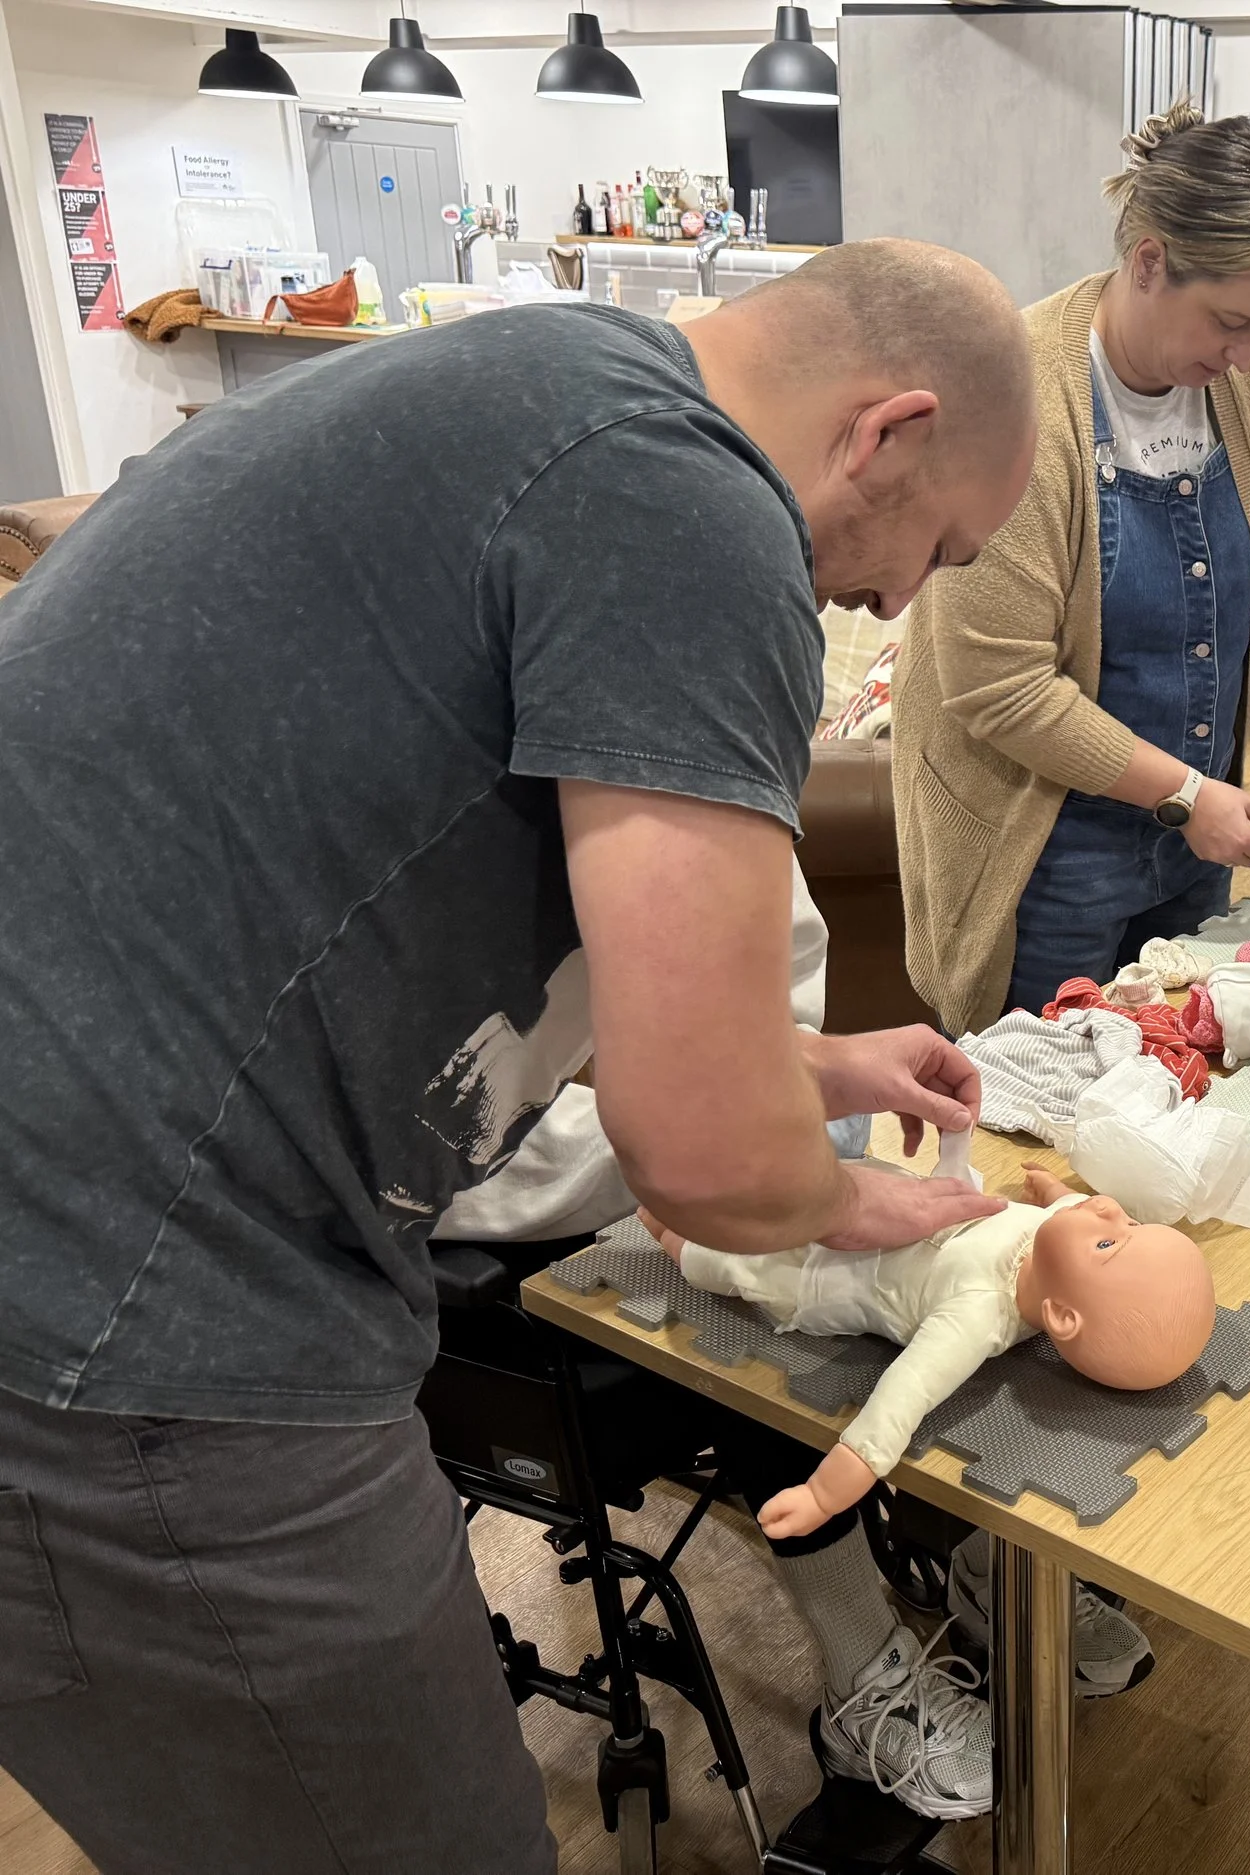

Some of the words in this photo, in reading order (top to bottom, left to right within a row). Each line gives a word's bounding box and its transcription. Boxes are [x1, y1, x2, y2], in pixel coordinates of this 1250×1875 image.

[184, 155, 202, 164] Food
[203, 156, 229, 167] Allergy
[186, 169, 231, 179] Intolerance?
[62, 192, 97, 204] UNDER
[64, 202, 81, 212] 25?
[509, 1460, 541, 1478] Lomax
